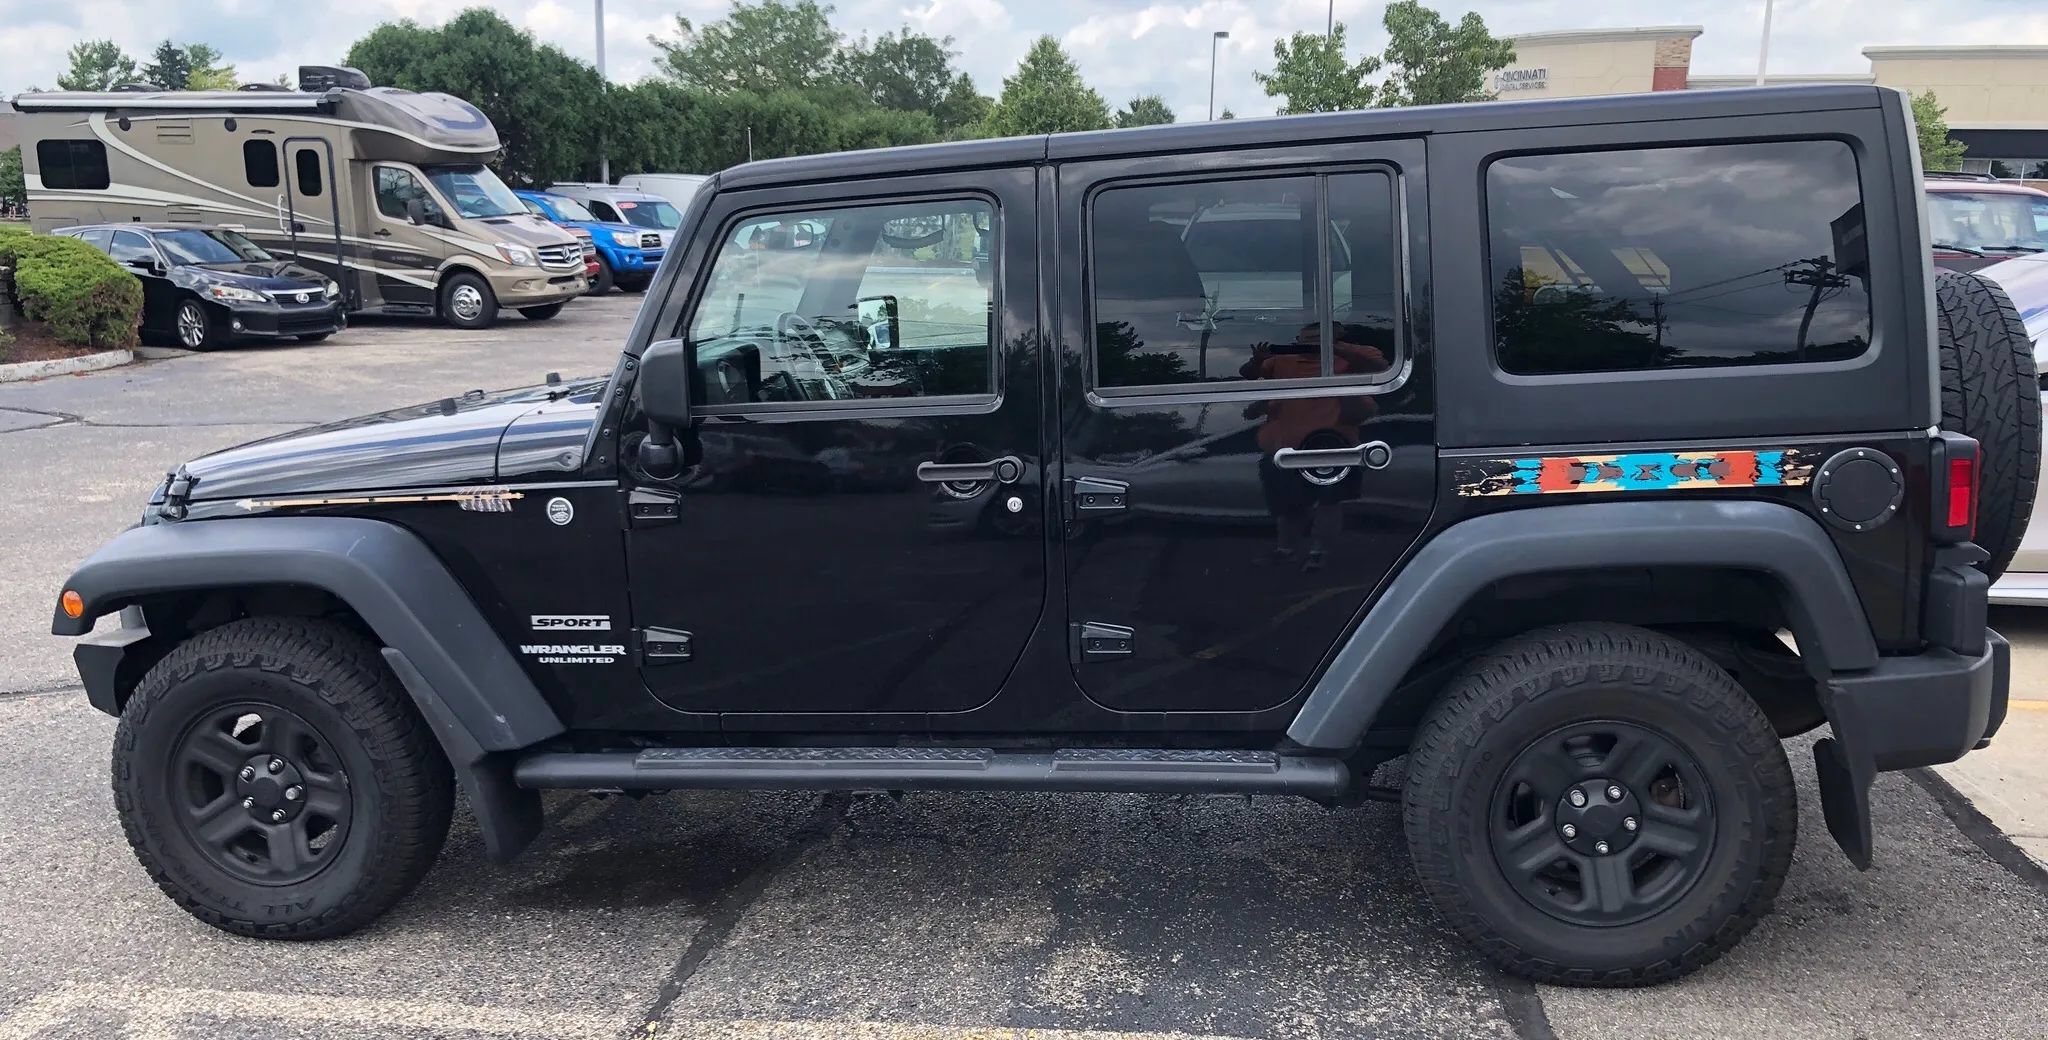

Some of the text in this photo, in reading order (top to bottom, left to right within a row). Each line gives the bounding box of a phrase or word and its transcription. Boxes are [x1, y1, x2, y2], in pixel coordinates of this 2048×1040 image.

[1503, 69, 1546, 82] CINCINNATI
[532, 618, 610, 628] SPORT
[520, 645, 626, 655] WRANGLER
[261, 896, 314, 914] ALL
